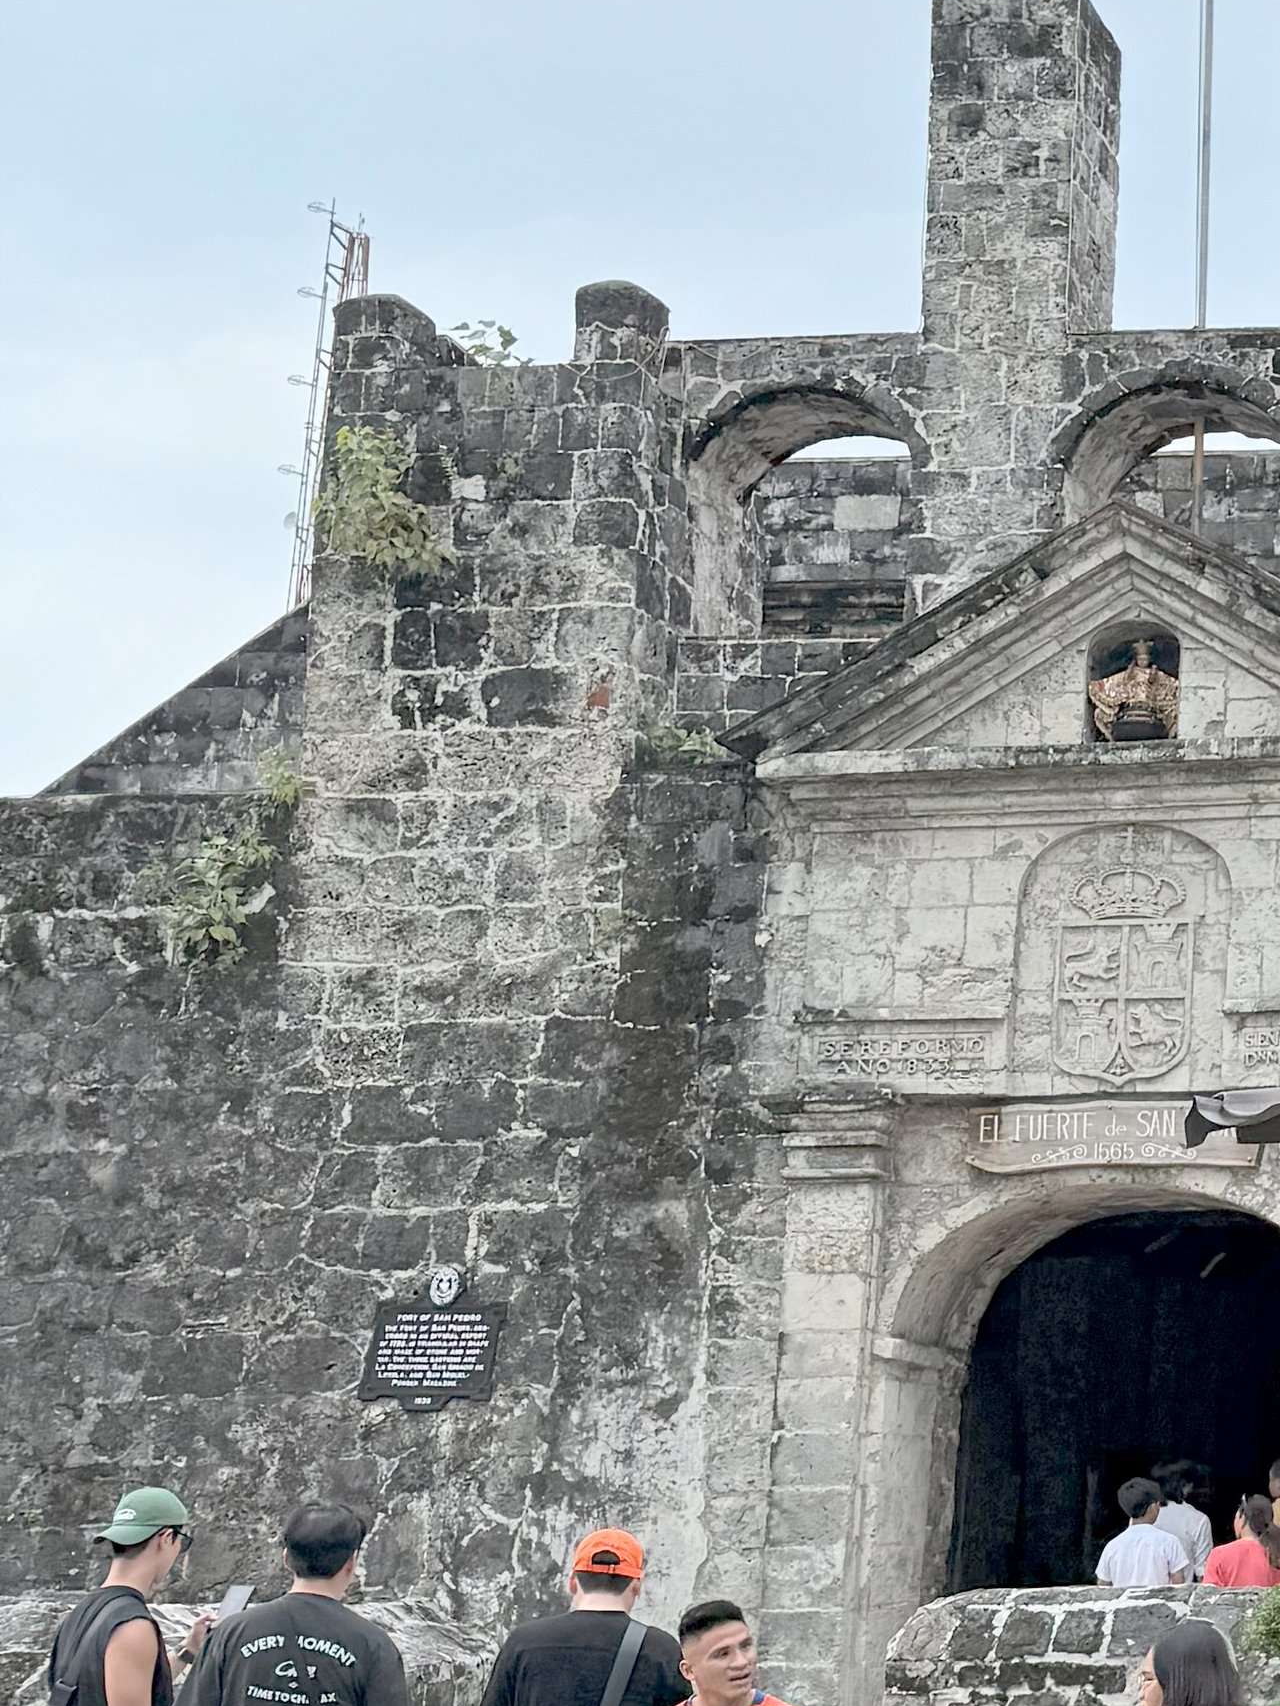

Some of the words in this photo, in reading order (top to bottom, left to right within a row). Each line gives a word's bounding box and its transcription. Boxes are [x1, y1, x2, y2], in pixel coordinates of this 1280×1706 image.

[979, 1114, 1004, 1142] EL
[1015, 1112, 1096, 1141] FUERTE
[1105, 1114, 1127, 1136] de
[1136, 1110, 1175, 1138] SAN
[1094, 1142, 1134, 1160] 1565
[240, 1634, 285, 1658] EVERY
[246, 1685, 274, 1701] TIME
[274, 1691, 290, 1703] TO
